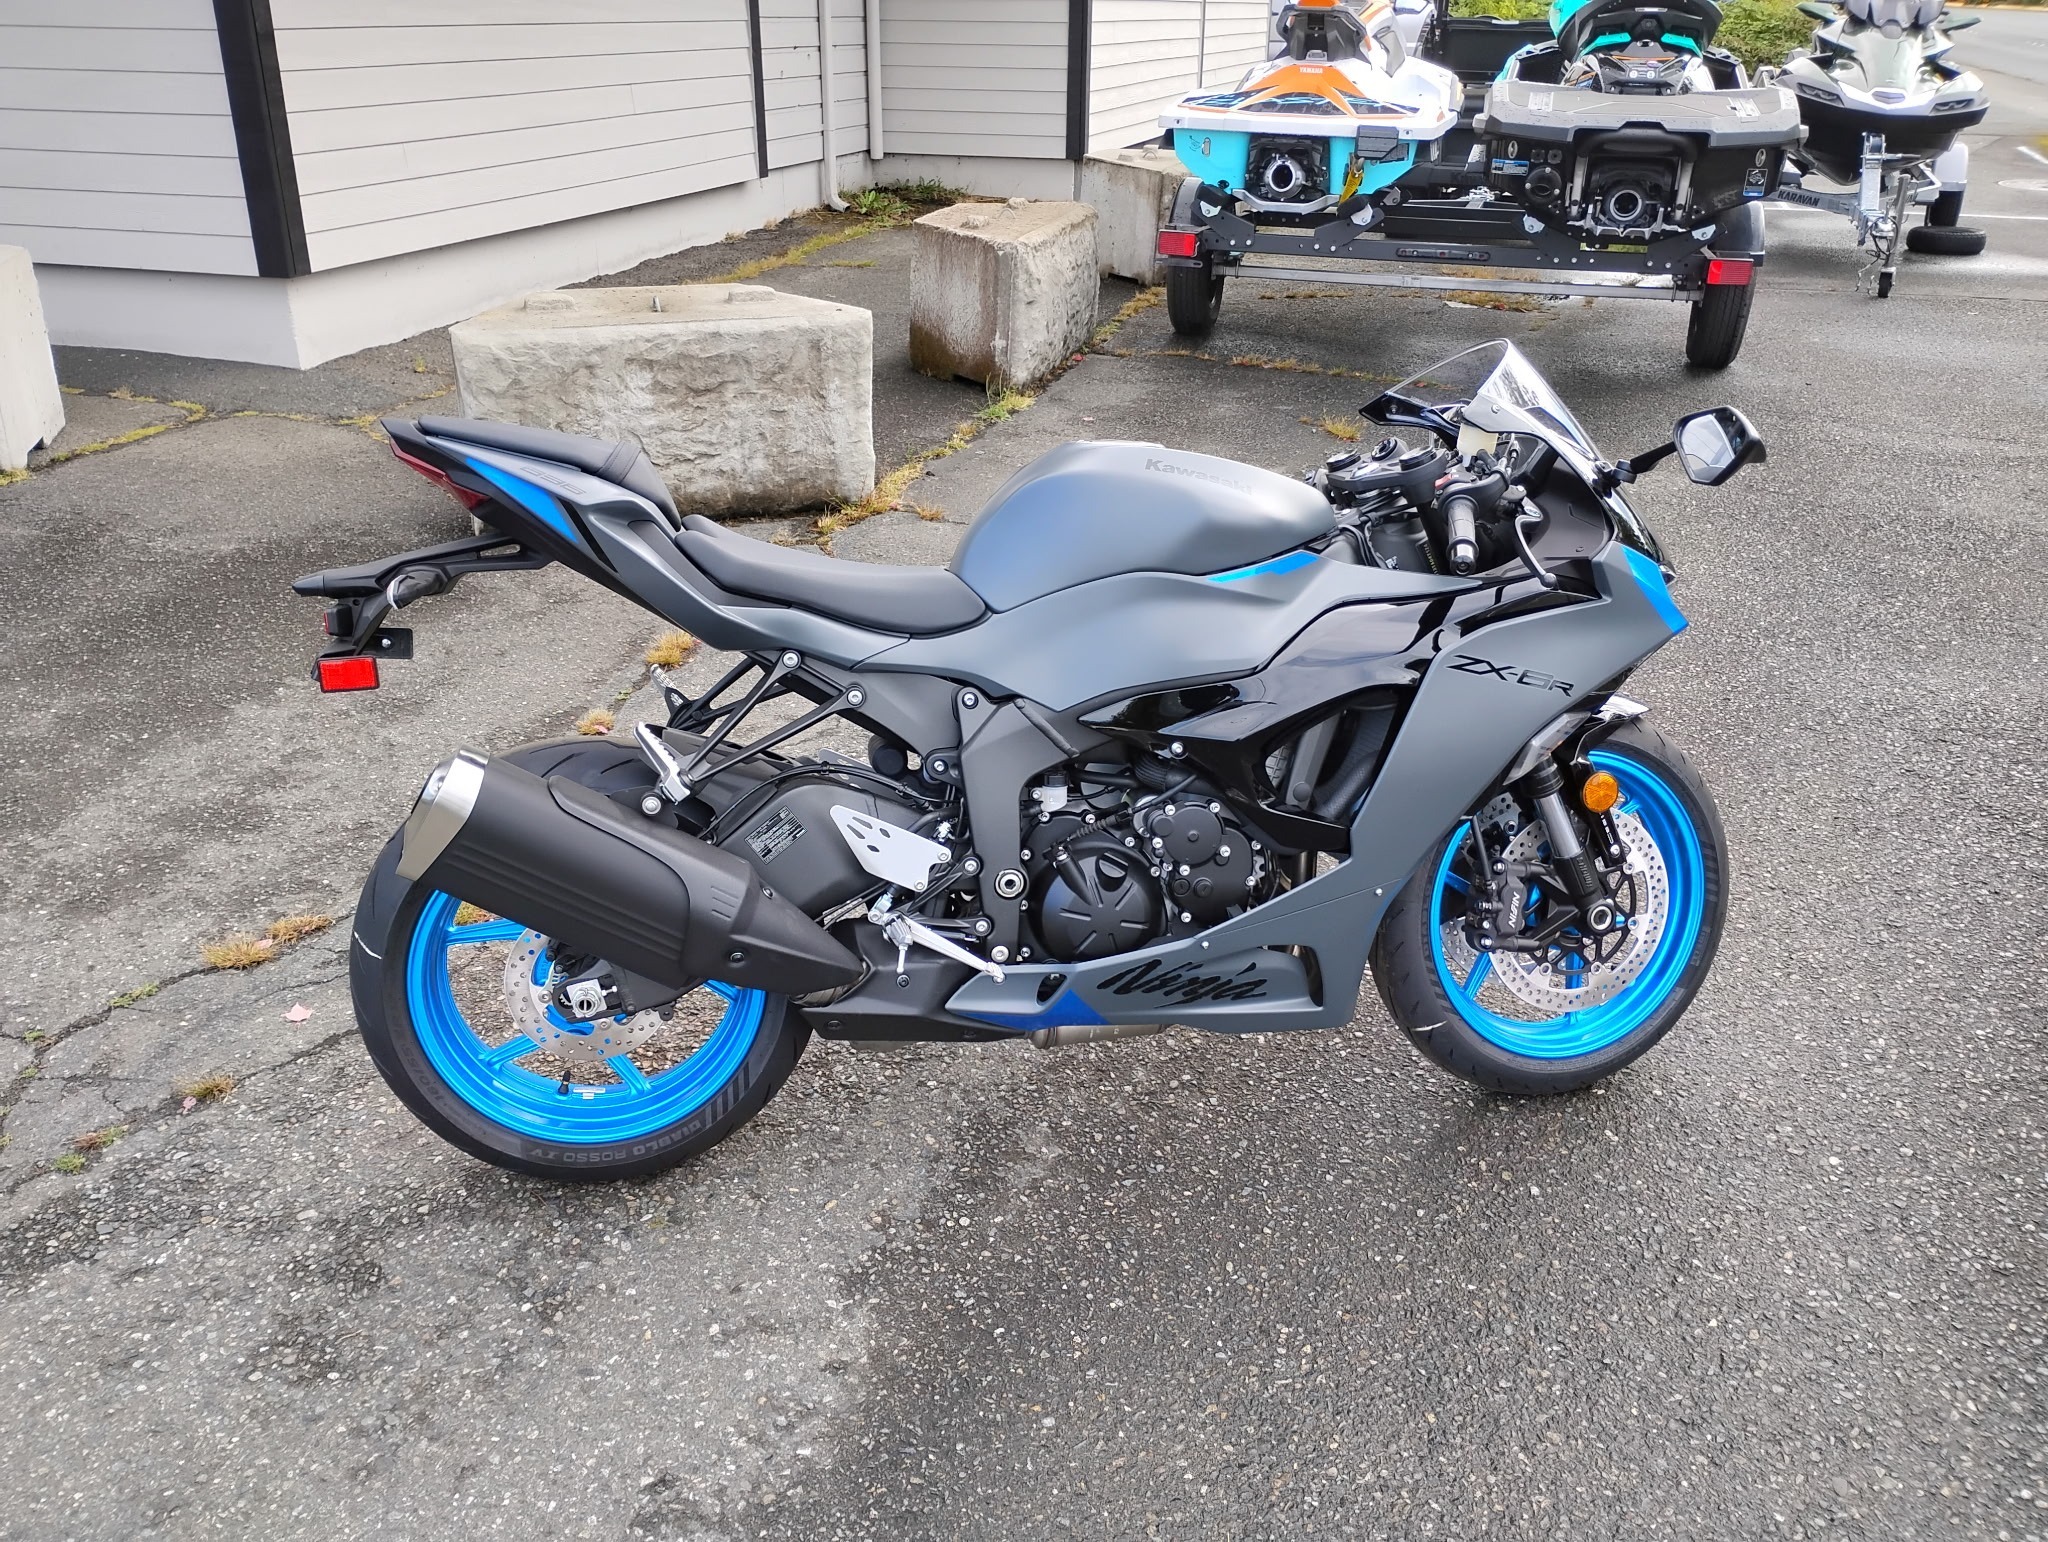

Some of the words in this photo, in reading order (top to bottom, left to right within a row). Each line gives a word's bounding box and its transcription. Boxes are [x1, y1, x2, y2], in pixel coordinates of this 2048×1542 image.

[1777, 190, 1820, 207] KARAVAN
[1144, 458, 1253, 495] Kawasaki
[1445, 654, 1575, 697] ZX-6R
[1096, 958, 1267, 1009] Ninja
[529, 1148, 560, 1160] IV
[563, 1148, 627, 1163] ROSSO
[632, 1119, 702, 1156] DIABLO
